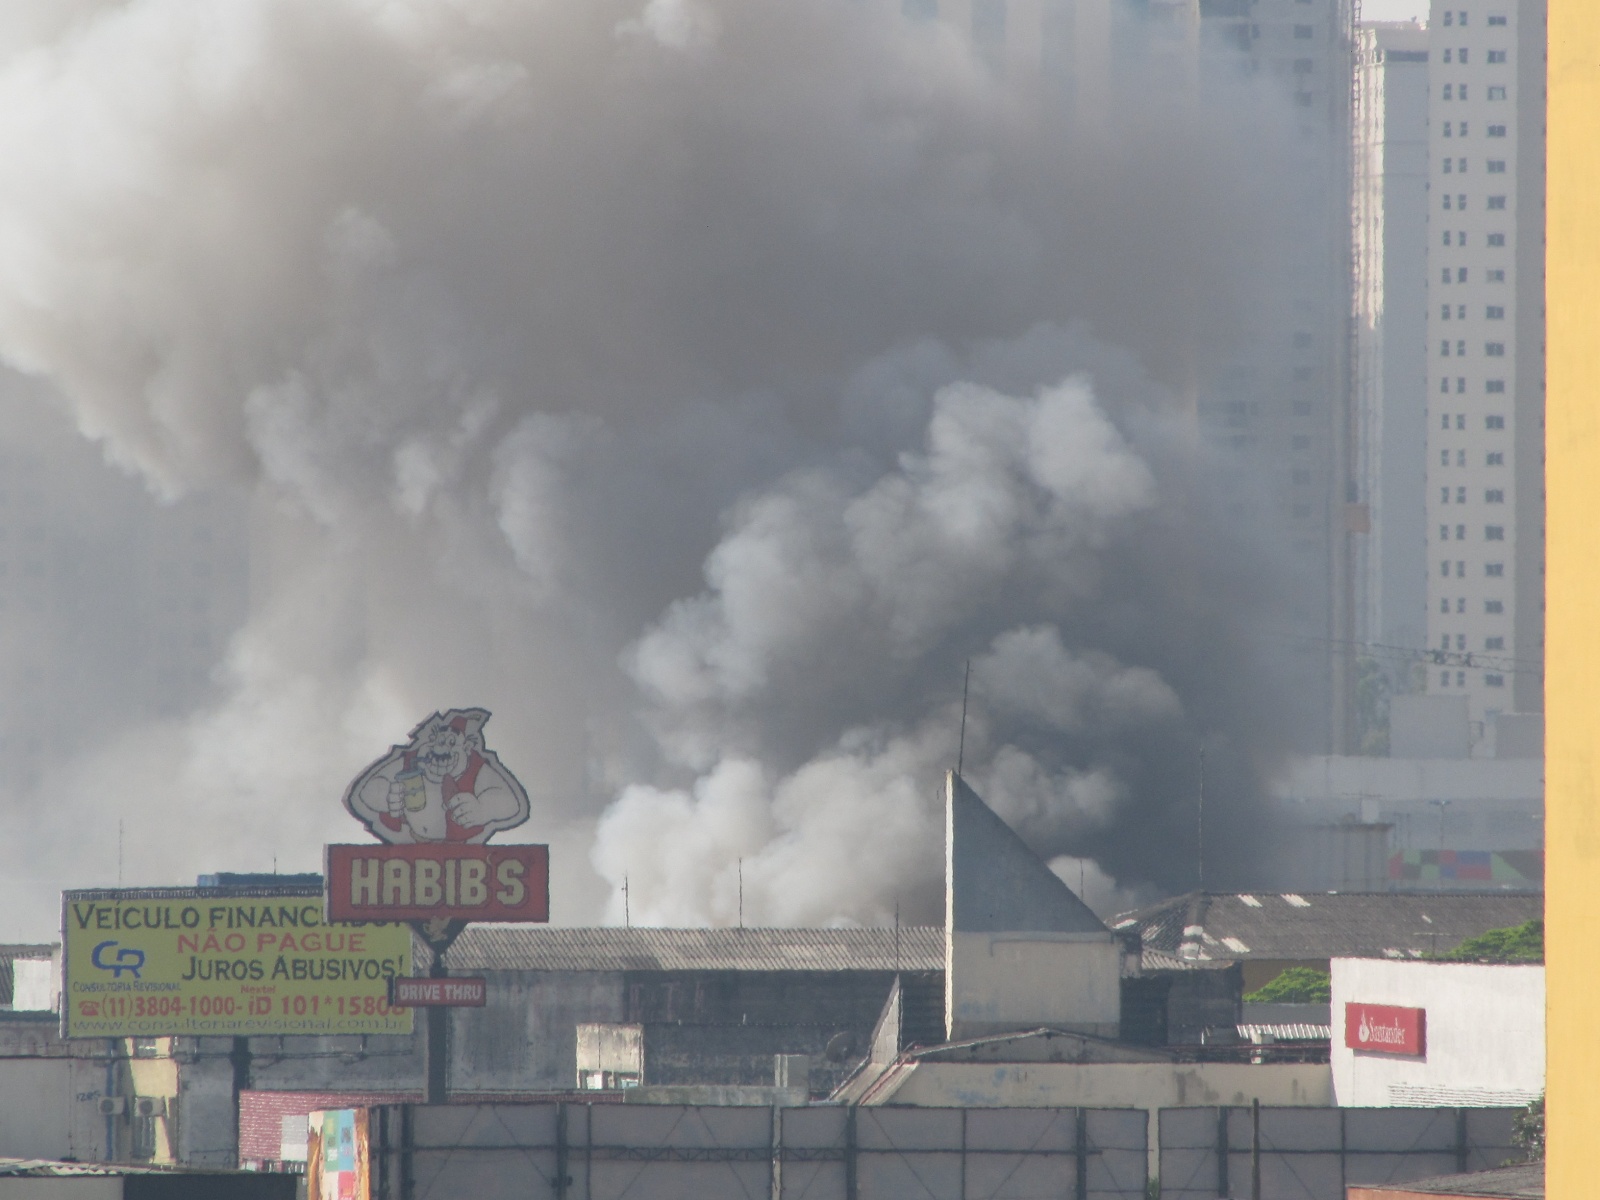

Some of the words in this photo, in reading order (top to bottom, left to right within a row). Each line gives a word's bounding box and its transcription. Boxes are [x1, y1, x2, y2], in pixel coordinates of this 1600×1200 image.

[351, 853, 526, 907] HABIB'S
[73, 901, 200, 929] VEÍCULO
[209, 905, 400, 928] FINANC
[177, 927, 246, 953] NÃO
[257, 932, 367, 952] PAGUE
[181, 955, 264, 981] JUROS
[271, 955, 403, 981] ABUSIVOS!
[399, 984, 440, 1000] DRIVE
[444, 984, 482, 1000] THRU
[1369, 1017, 1406, 1045] Santander
